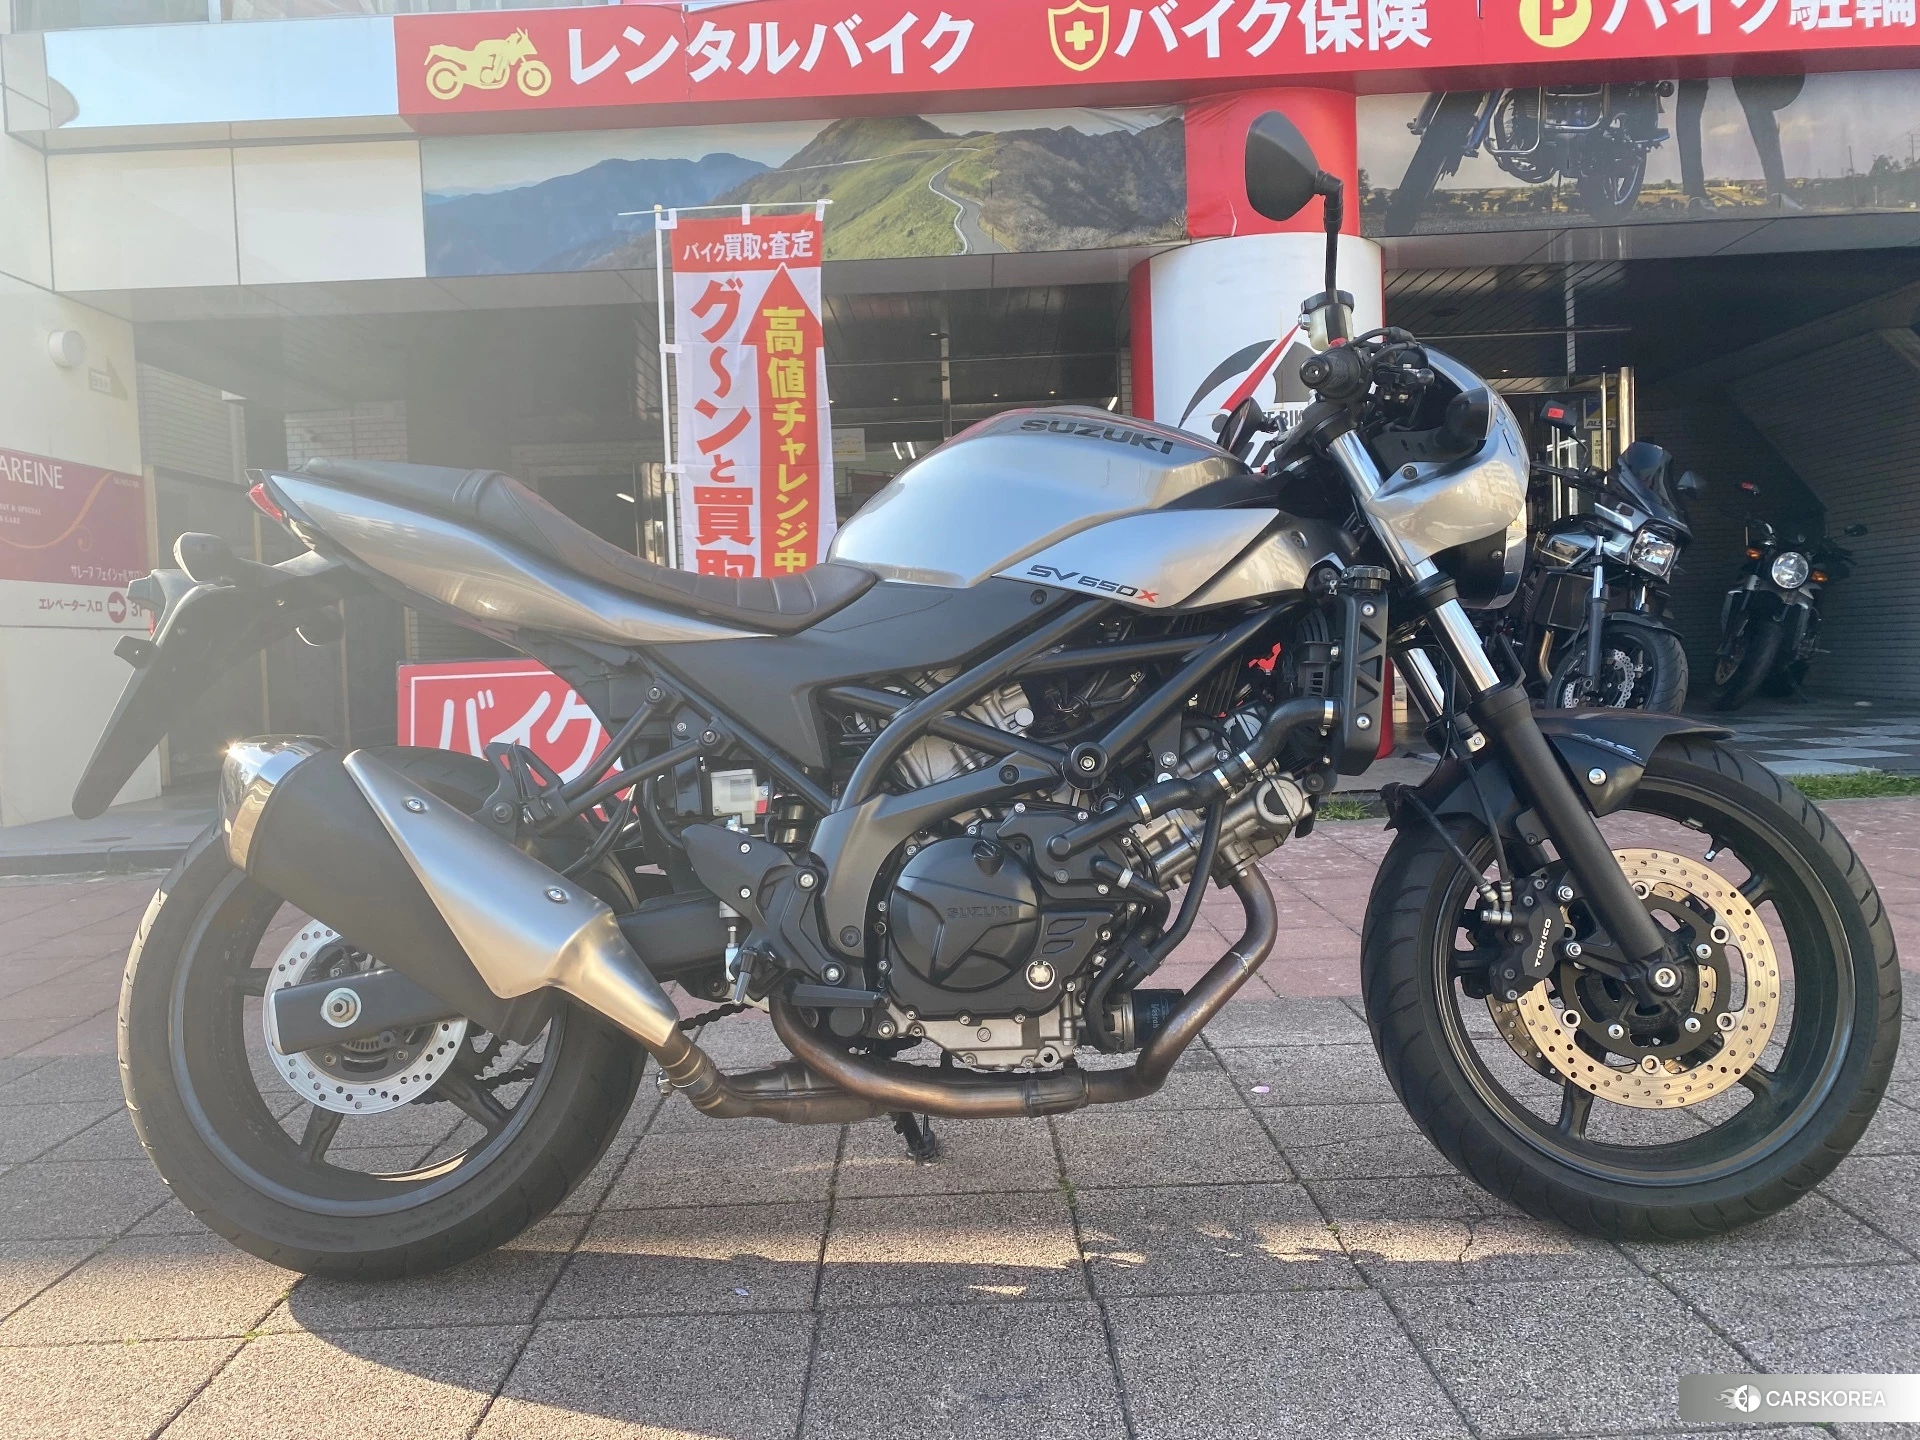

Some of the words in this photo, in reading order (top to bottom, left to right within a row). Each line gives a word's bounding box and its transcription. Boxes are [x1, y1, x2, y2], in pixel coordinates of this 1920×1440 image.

[568, 11, 974, 85] レンタルバイク
[1114, 0, 1433, 58] バイク保険
[763, 306, 809, 573] 高値チャレンジ中
[1020, 419, 1174, 455] SUZUKI
[39, 598, 103, 613] エレベーター入口
[946, 905, 1014, 919] SUZUKI
[1534, 918, 1553, 968] TOKICO
